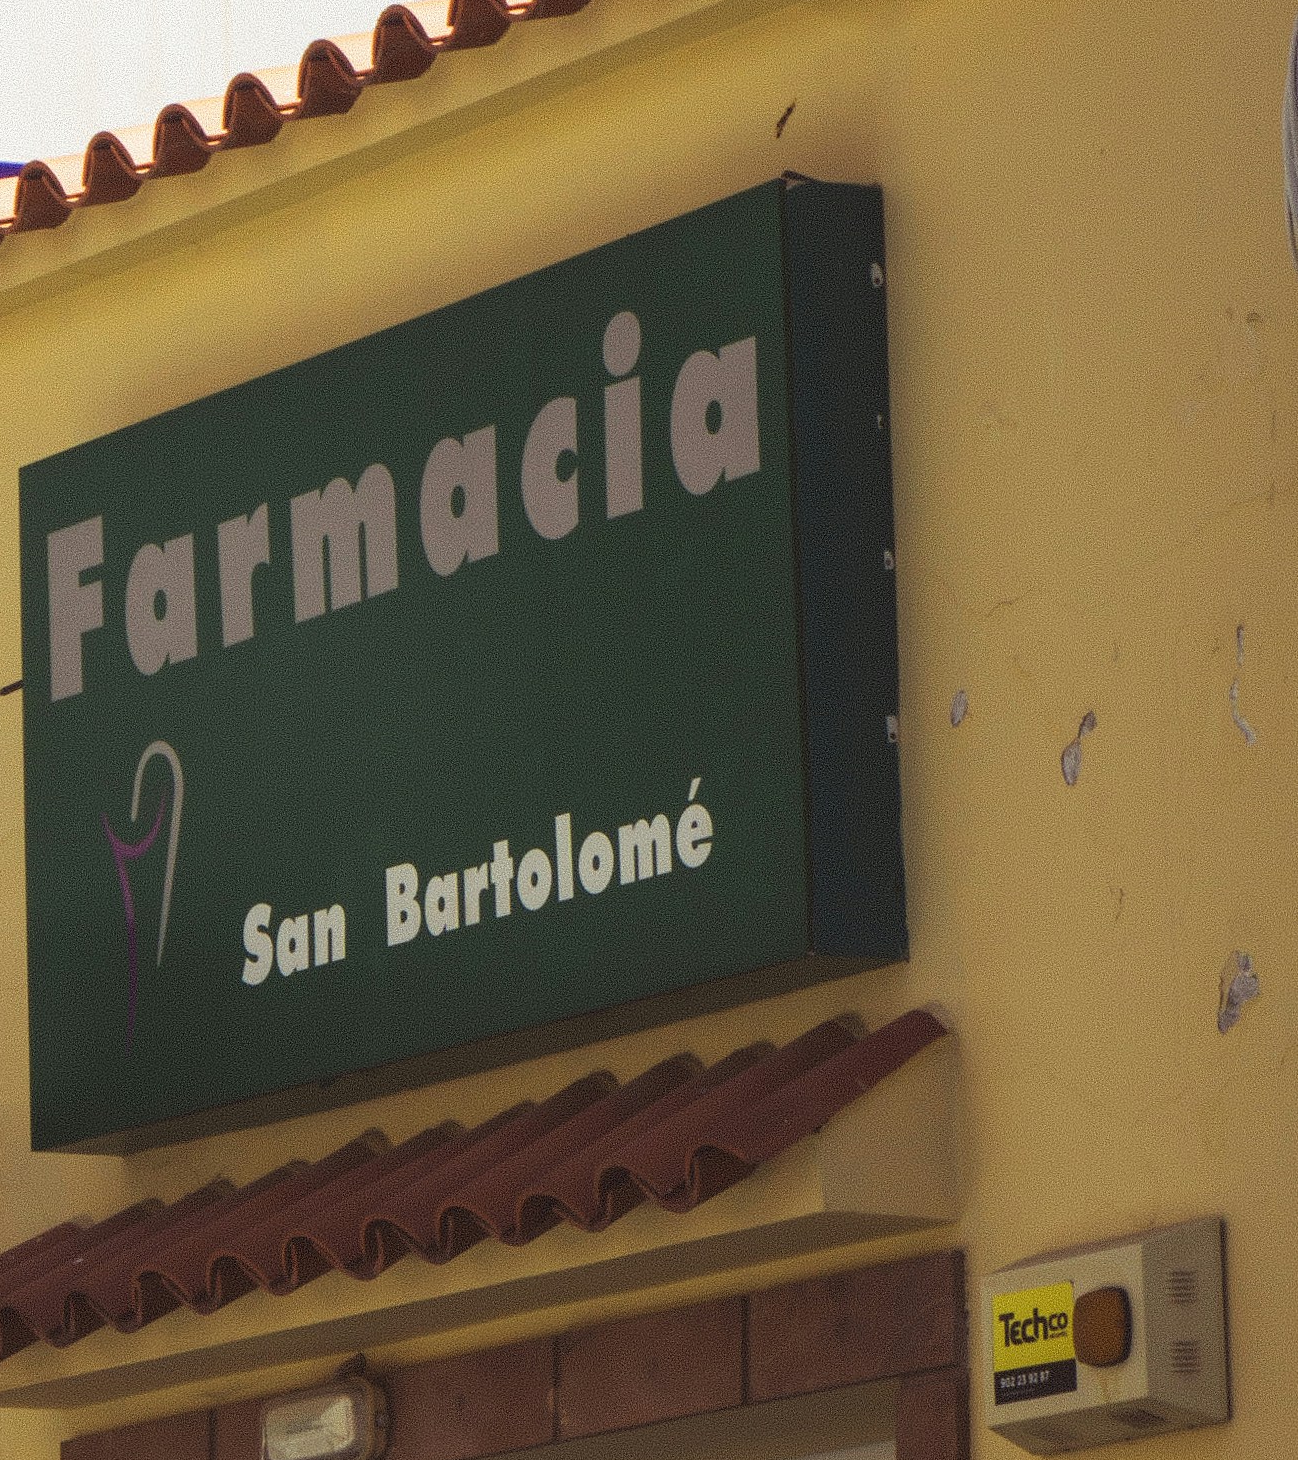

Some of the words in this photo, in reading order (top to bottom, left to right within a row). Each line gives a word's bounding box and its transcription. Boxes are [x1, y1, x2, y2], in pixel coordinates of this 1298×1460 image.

[47, 311, 761, 703] Farmacia
[242, 902, 346, 986] San
[386, 777, 714, 948] Bartolomé
[998, 1307, 1069, 1348] Techco
